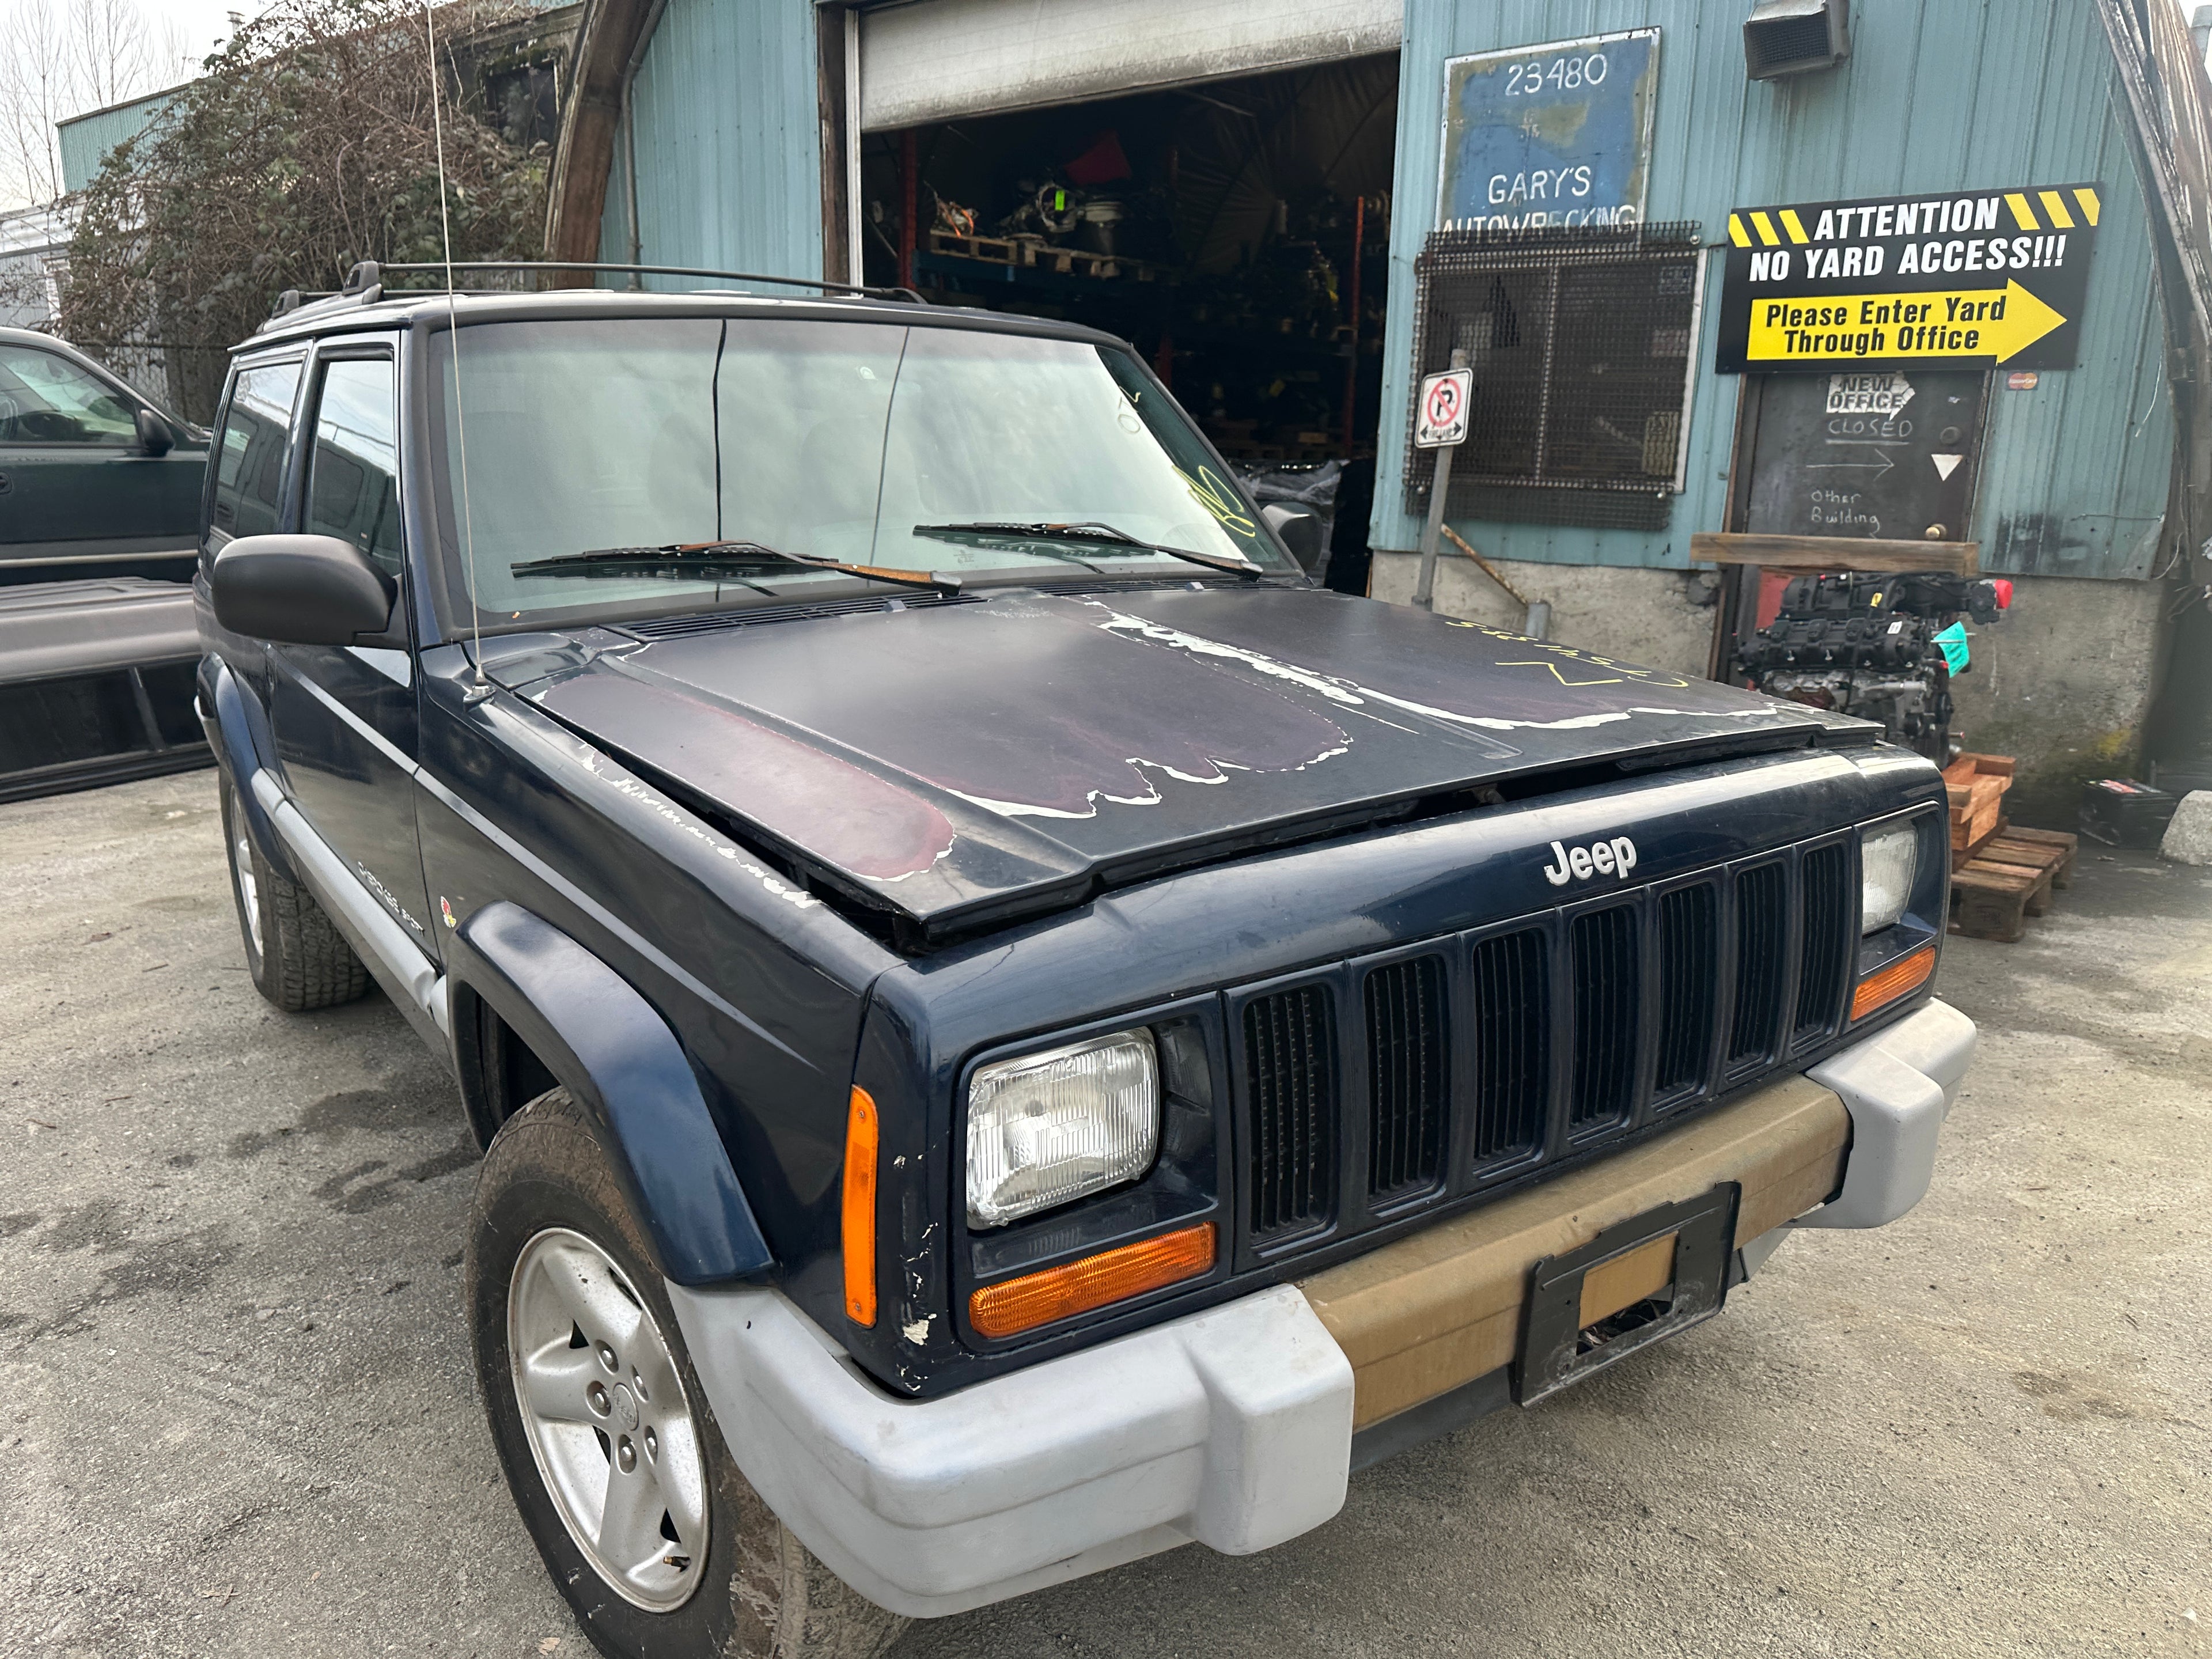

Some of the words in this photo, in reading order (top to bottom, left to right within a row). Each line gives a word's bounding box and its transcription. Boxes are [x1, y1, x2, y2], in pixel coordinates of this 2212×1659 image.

[1505, 53, 1608, 97] 23480
[1488, 165, 1591, 204] GARY'S
[1814, 196, 2000, 241] ATTENTION
[1749, 250, 1790, 282] NO
[1805, 245, 1885, 279] YARD
[1897, 234, 2067, 274] ACCESS!!!
[1766, 303, 1847, 327] Please
[1860, 299, 1931, 324] Enter
[1945, 296, 2007, 322] Yard
[1785, 327, 1885, 355] Through
[1897, 325, 1979, 350] Office
[1844, 377, 1892, 392] NEW
[1830, 392, 1903, 409] OFFICE
[1828, 418, 1913, 437] CLOSED
[1811, 490, 1862, 503] Other
[1811, 506, 1880, 535] Building
[1543, 836, 1637, 886] Jeep
